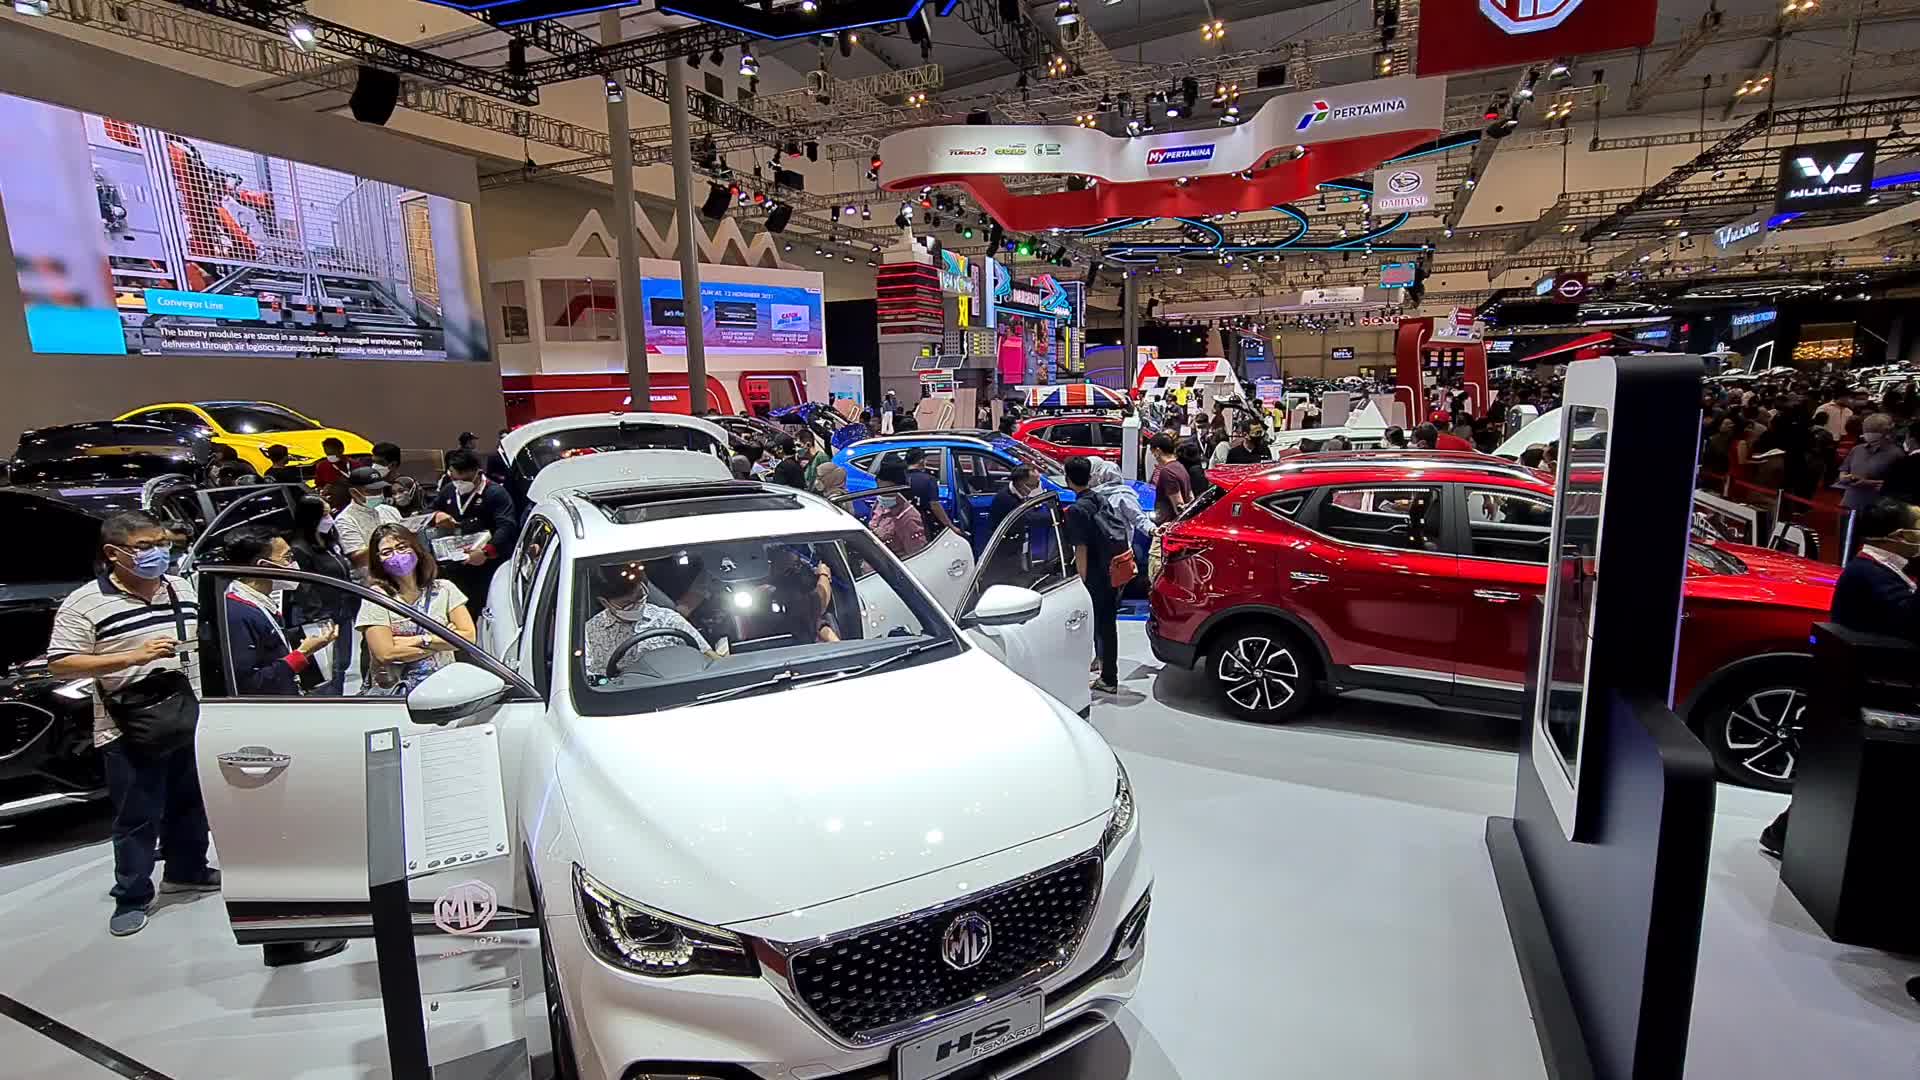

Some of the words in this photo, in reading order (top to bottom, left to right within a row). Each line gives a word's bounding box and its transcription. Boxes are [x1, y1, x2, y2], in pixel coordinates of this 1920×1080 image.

[1333, 100, 1406, 119] PERTAMINA
[1149, 147, 1212, 163] MyPERTAMINA
[1789, 184, 1863, 199] WULING
[1380, 196, 1427, 208] DAIHATSU
[157, 296, 203, 310] Conveyor
[205, 302, 224, 310] Line
[160, 327, 177, 337] The
[178, 328, 208, 339] battery
[208, 330, 242, 340] modules
[243, 331, 256, 340] are
[256, 332, 280, 341] stored
[281, 333, 288, 341] in
[161, 339, 201, 349] delivered
[202, 340, 234, 352] through
[235, 342, 245, 350] air
[246, 341, 275, 352] logistics
[276, 343, 320, 353] automatically
[321, 345, 333, 353] and
[437, 885, 494, 931] MG
[946, 915, 990, 968] MG
[936, 1018, 1011, 1062] HS
